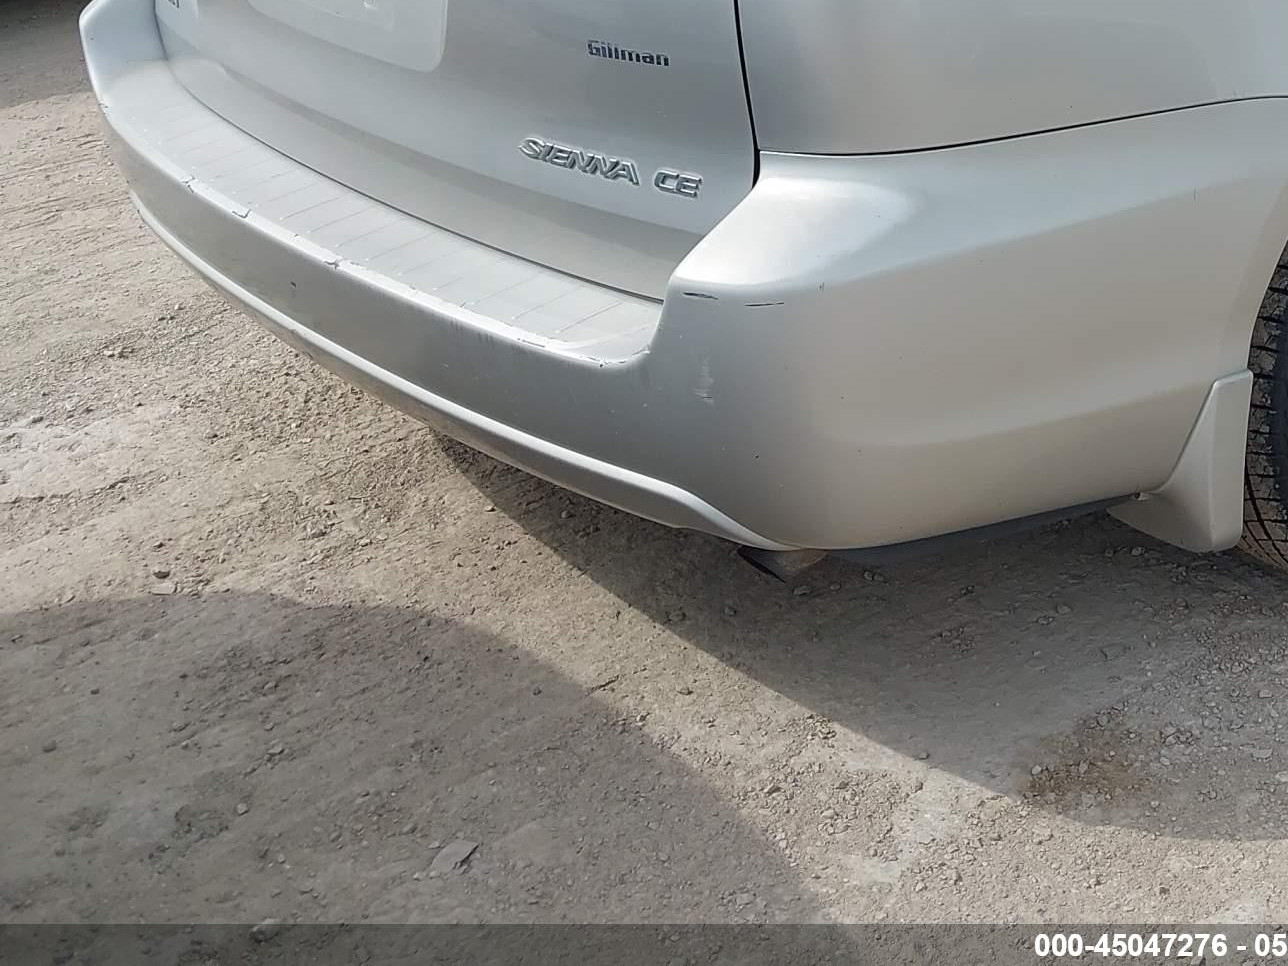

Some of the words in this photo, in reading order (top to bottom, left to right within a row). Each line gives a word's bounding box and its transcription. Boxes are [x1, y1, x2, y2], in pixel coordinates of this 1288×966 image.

[587, 39, 669, 67] Gillman
[517, 137, 640, 186] SIENNA
[654, 169, 703, 198] CE
